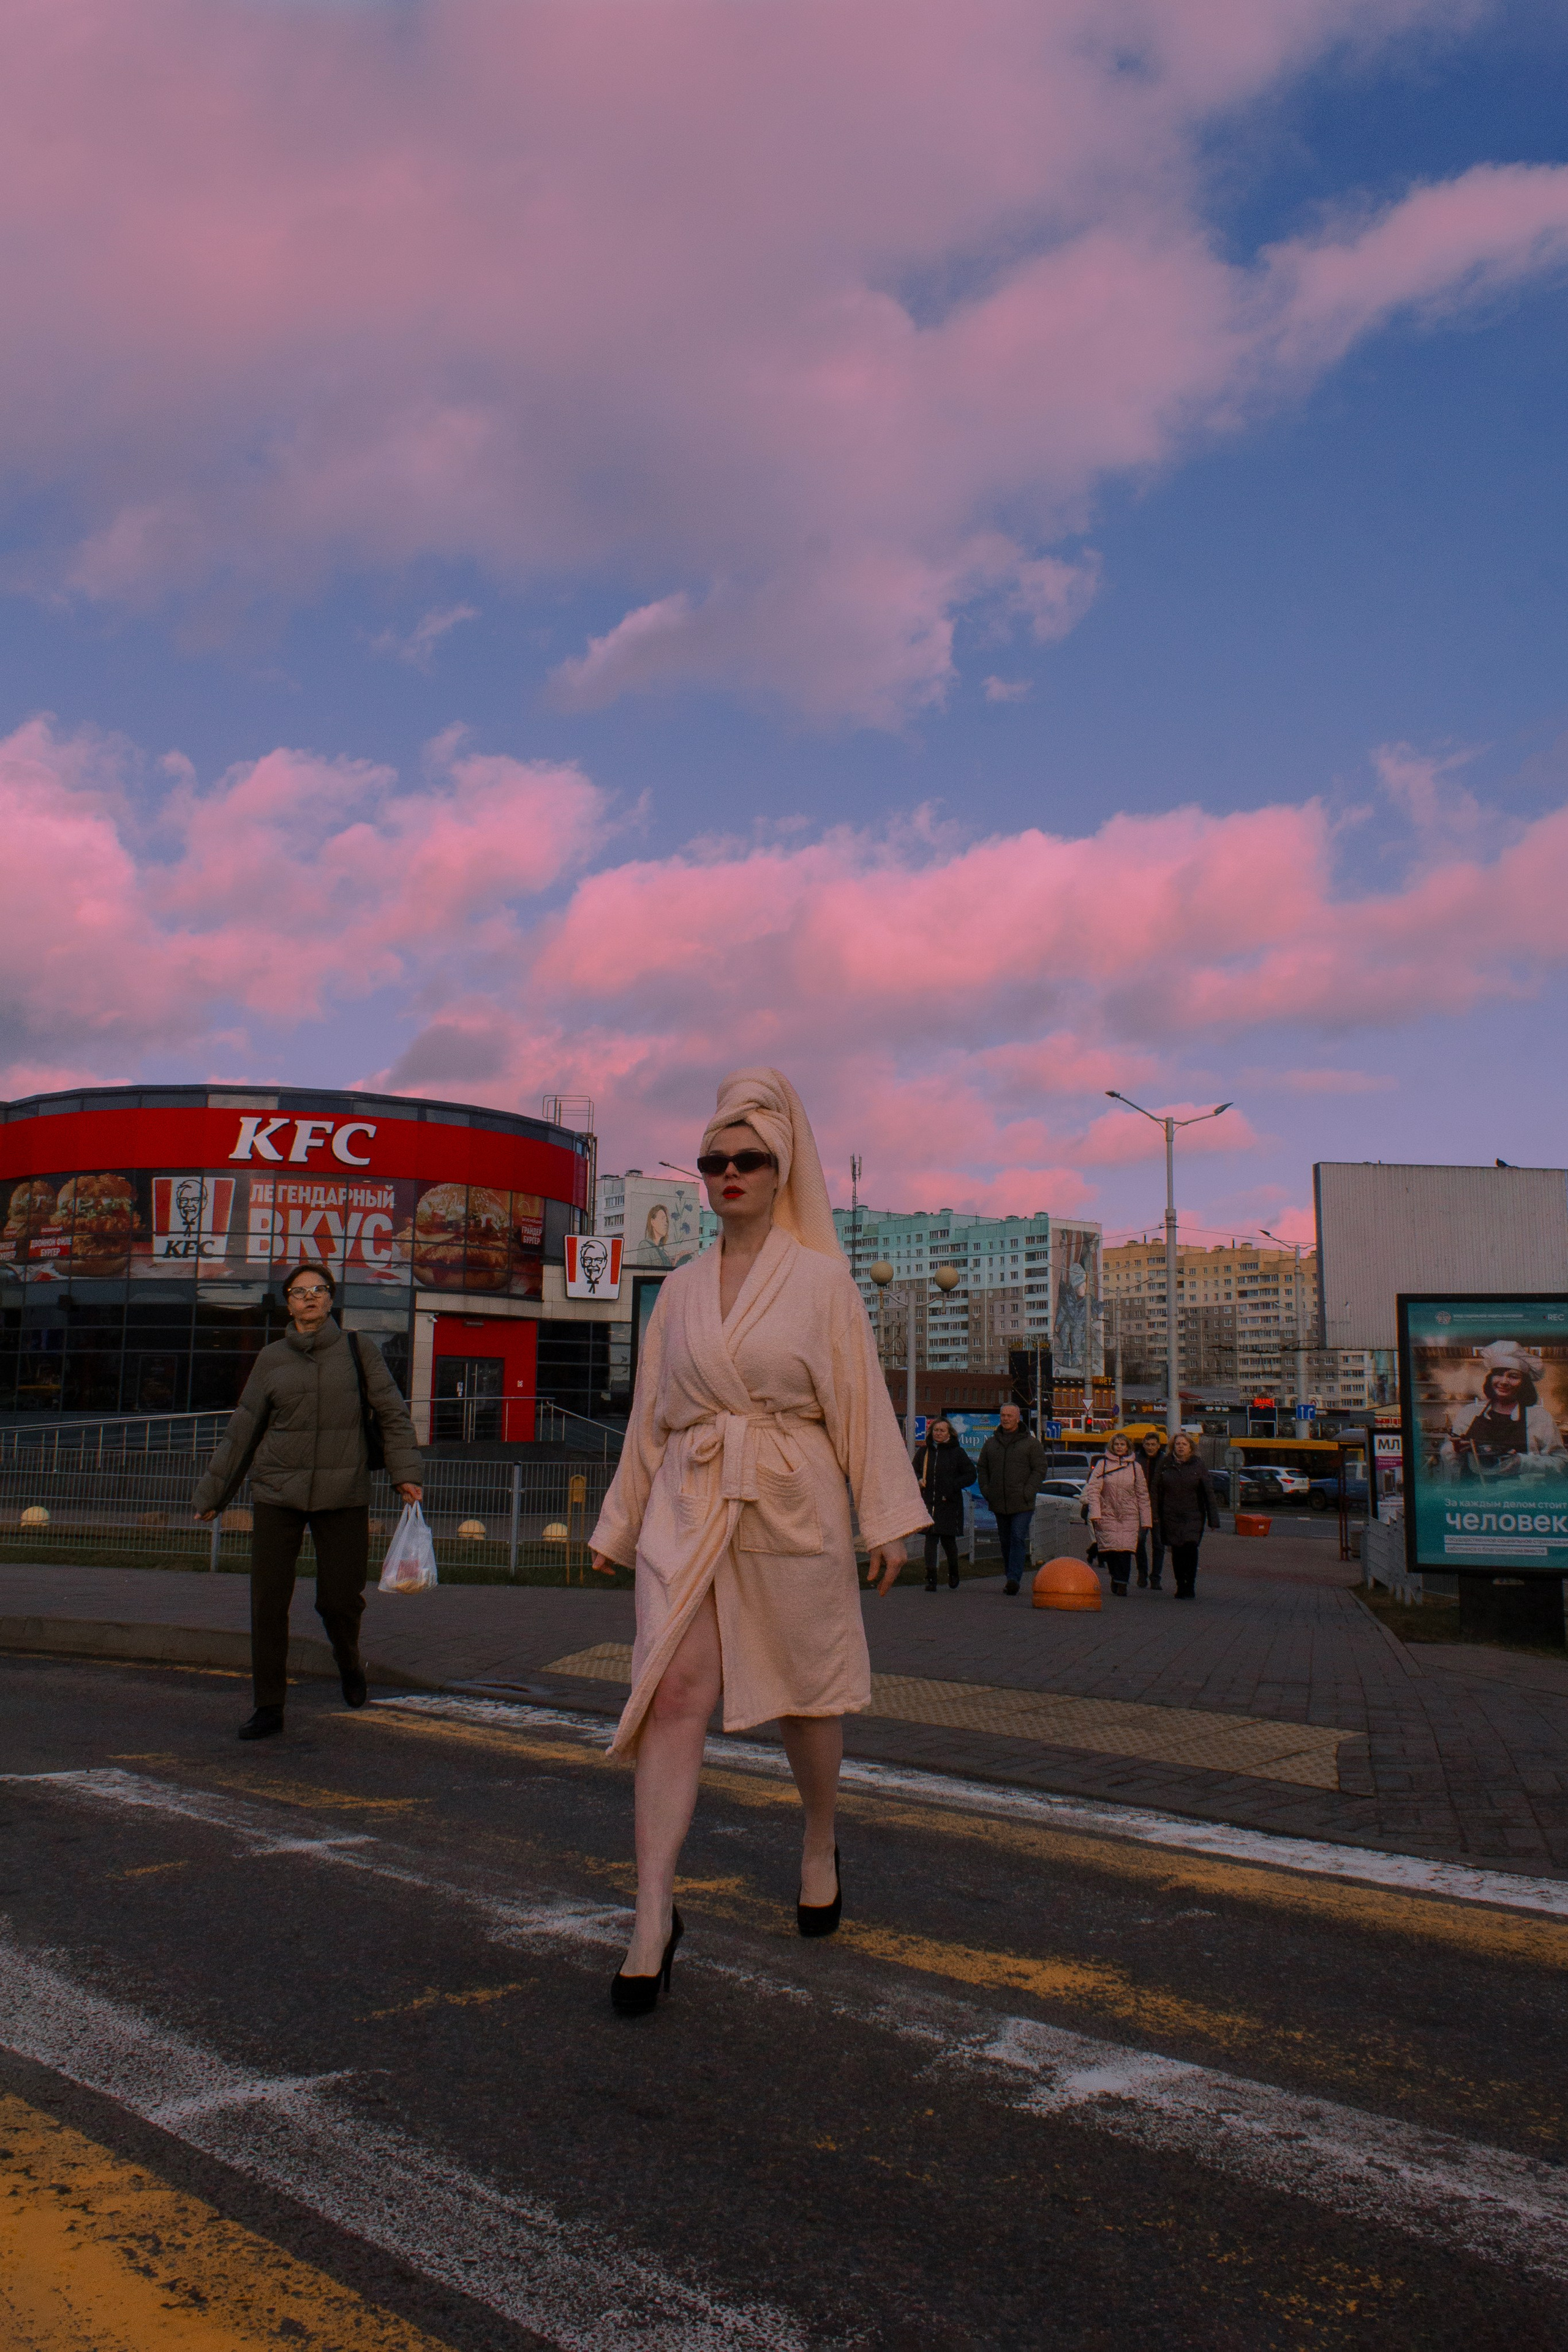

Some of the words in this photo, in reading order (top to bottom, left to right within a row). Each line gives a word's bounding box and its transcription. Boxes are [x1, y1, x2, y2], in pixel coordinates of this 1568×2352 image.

[228, 1117, 377, 1166] KFC
[249, 1184, 395, 1209] ЛЕГЕНДАРНЫЙ
[246, 1208, 394, 1268] ВКУС
[521, 1226, 543, 1237] ГРАНДЕР
[523, 1235, 541, 1245] БУРГЕР
[40, 1247, 61, 1257] БУРГЕР
[162, 1240, 216, 1259] KFC
[1378, 1438, 1400, 1450] МЛ
[1444, 1498, 1458, 1507] За
[1459, 1500, 1501, 1509] каждым
[1446, 1512, 1568, 1532] человек
